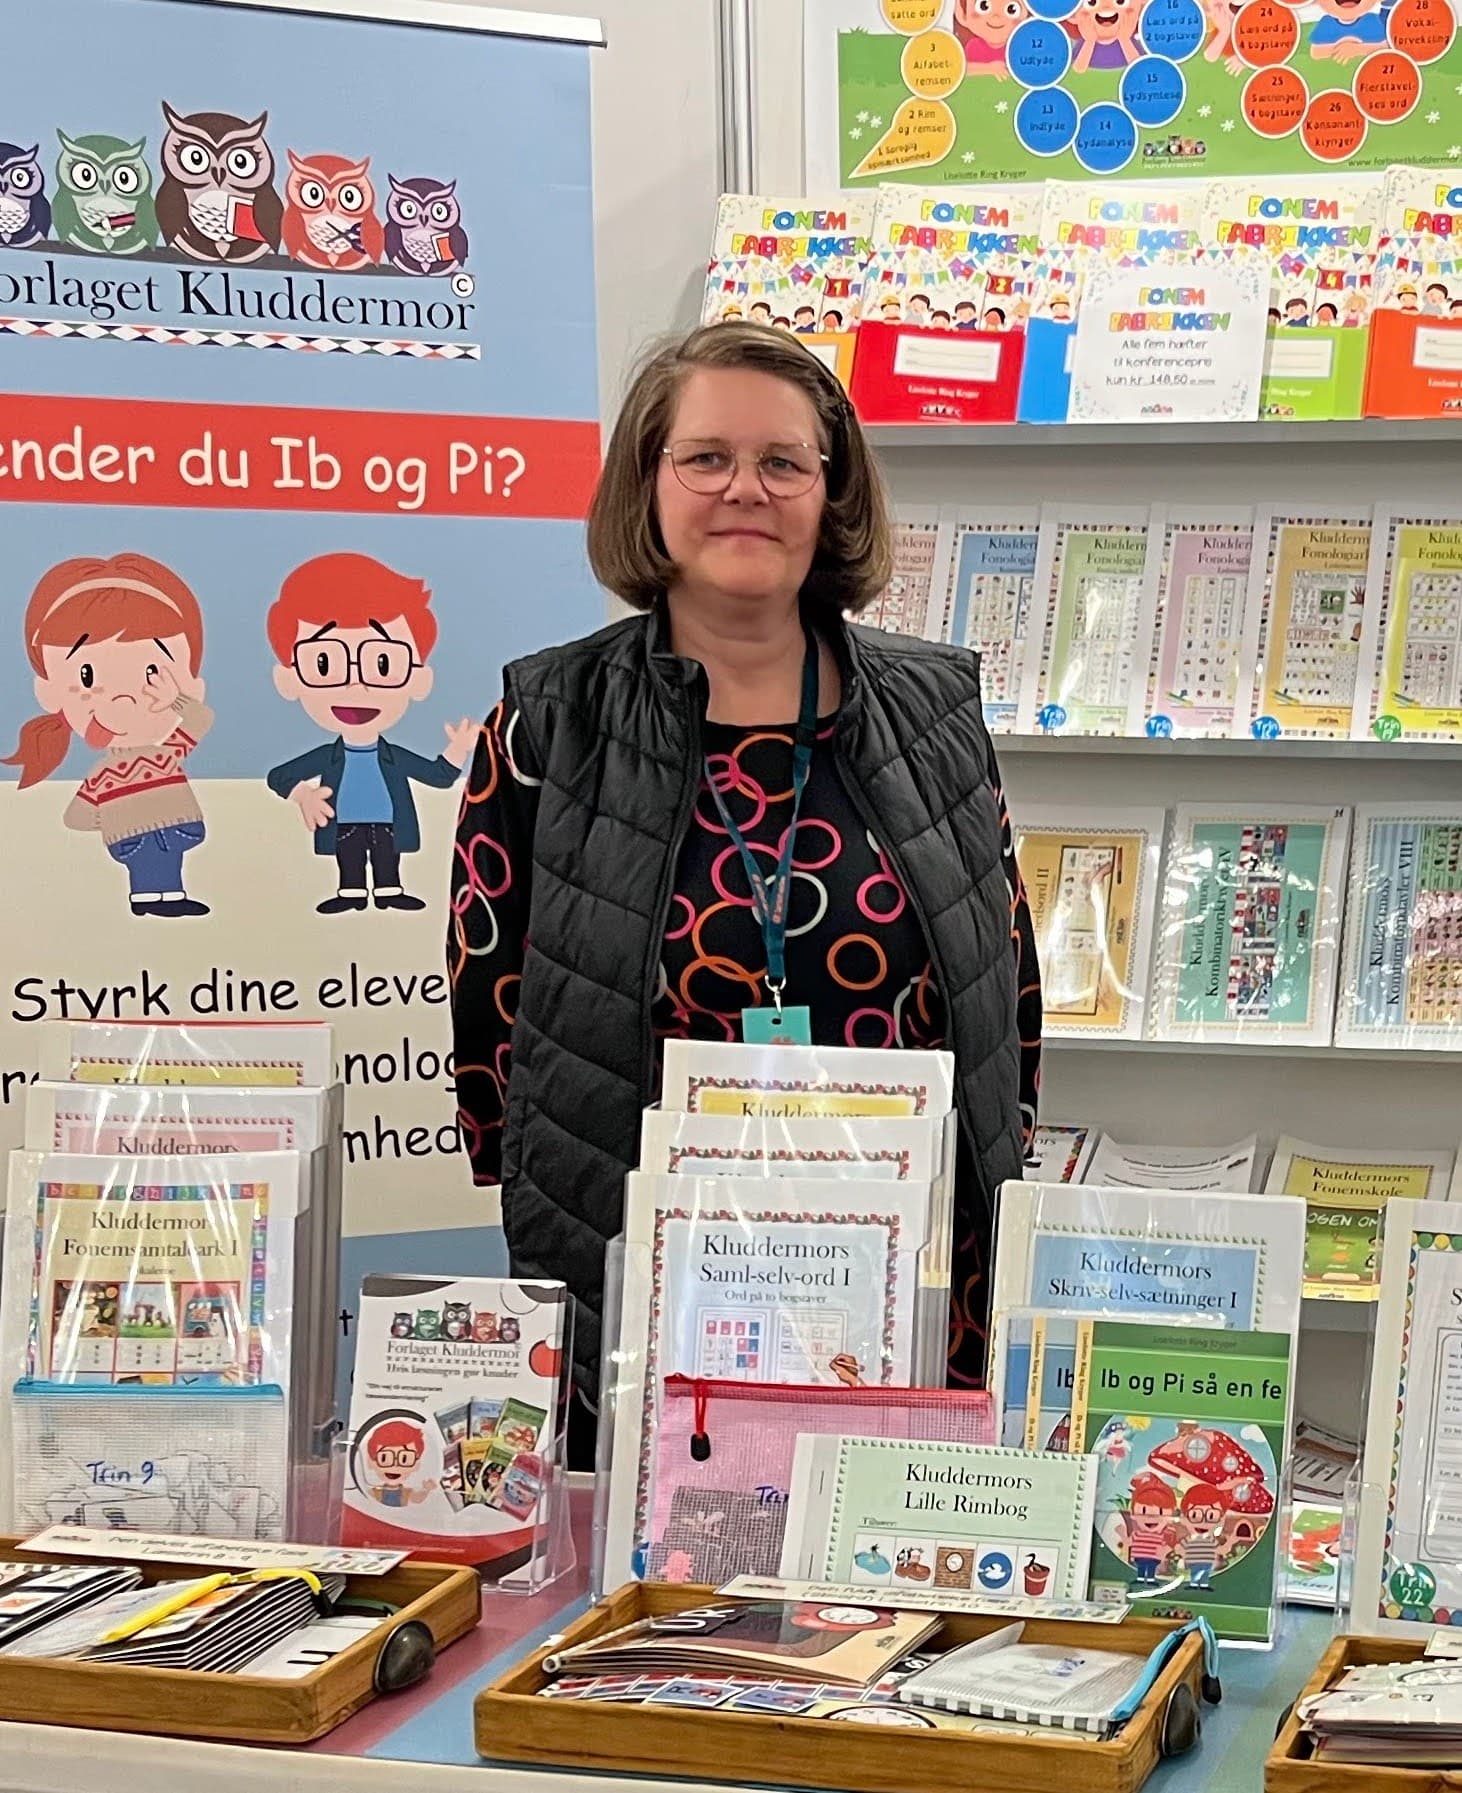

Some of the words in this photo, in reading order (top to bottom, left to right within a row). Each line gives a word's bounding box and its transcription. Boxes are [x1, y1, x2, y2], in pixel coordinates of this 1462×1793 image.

[1260, 7, 1273, 17] 24
[930, 43, 936, 52] 3
[1031, 39, 1043, 48] 12
[1147, 73, 1159, 83] 15
[1271, 76, 1283, 86] 25
[1099, 120, 1111, 131] 14
[889, 223, 1039, 253] FABRIKKEN
[1216, 220, 1372, 248] FABRIKKEN
[177, 270, 476, 331] Kluddermor
[1138, 287, 1207, 306] FONEM
[1108, 312, 1232, 332] FABRIKKEN
[1122, 339, 1141, 350] Alle
[1144, 338, 1166, 350] fem
[1169, 339, 1209, 350] hæfter
[1114, 357, 1124, 367] til
[1106, 375, 1128, 386] kun
[178, 431, 250, 489] du
[270, 436, 342, 492] Ib
[363, 454, 428, 509] og
[448, 441, 527, 497] Pi?
[1398, 839, 1414, 872] VIII
[12, 970, 171, 1021] Styrk
[190, 967, 299, 1014] dine
[317, 962, 448, 1009] eleve
[1312, 1167, 1410, 1183] Kluddermors
[1312, 1181, 1404, 1197] Fonemskole
[91, 1211, 214, 1231] Kluddermor
[702, 1233, 850, 1260] Kluddermors
[700, 1262, 835, 1287] Saml-selv-ord
[843, 1267, 851, 1287] I
[1080, 1251, 1212, 1281] Kluddermors
[724, 1289, 747, 1300] Ord
[749, 1290, 762, 1303] på
[1048, 1278, 1226, 1309] Skriv-selv-sætninger
[386, 1341, 438, 1356] Forlaget
[442, 1341, 520, 1359] Kluddermor
[386, 1363, 409, 1374] Hvis
[1101, 1368, 1121, 1388] Ib
[1128, 1375, 1155, 1396] og
[1163, 1373, 1185, 1393] Pi
[1192, 1372, 1218, 1395] så
[1226, 1381, 1253, 1398] en
[1261, 1379, 1282, 1399] fe
[86, 1461, 131, 1484] Trin
[141, 1461, 154, 1484] 9
[905, 1462, 1034, 1490] Kluddermors
[904, 1491, 946, 1512] Lille
[953, 1494, 1030, 1521] Rimbog
[1402, 1587, 1425, 1606] 22
